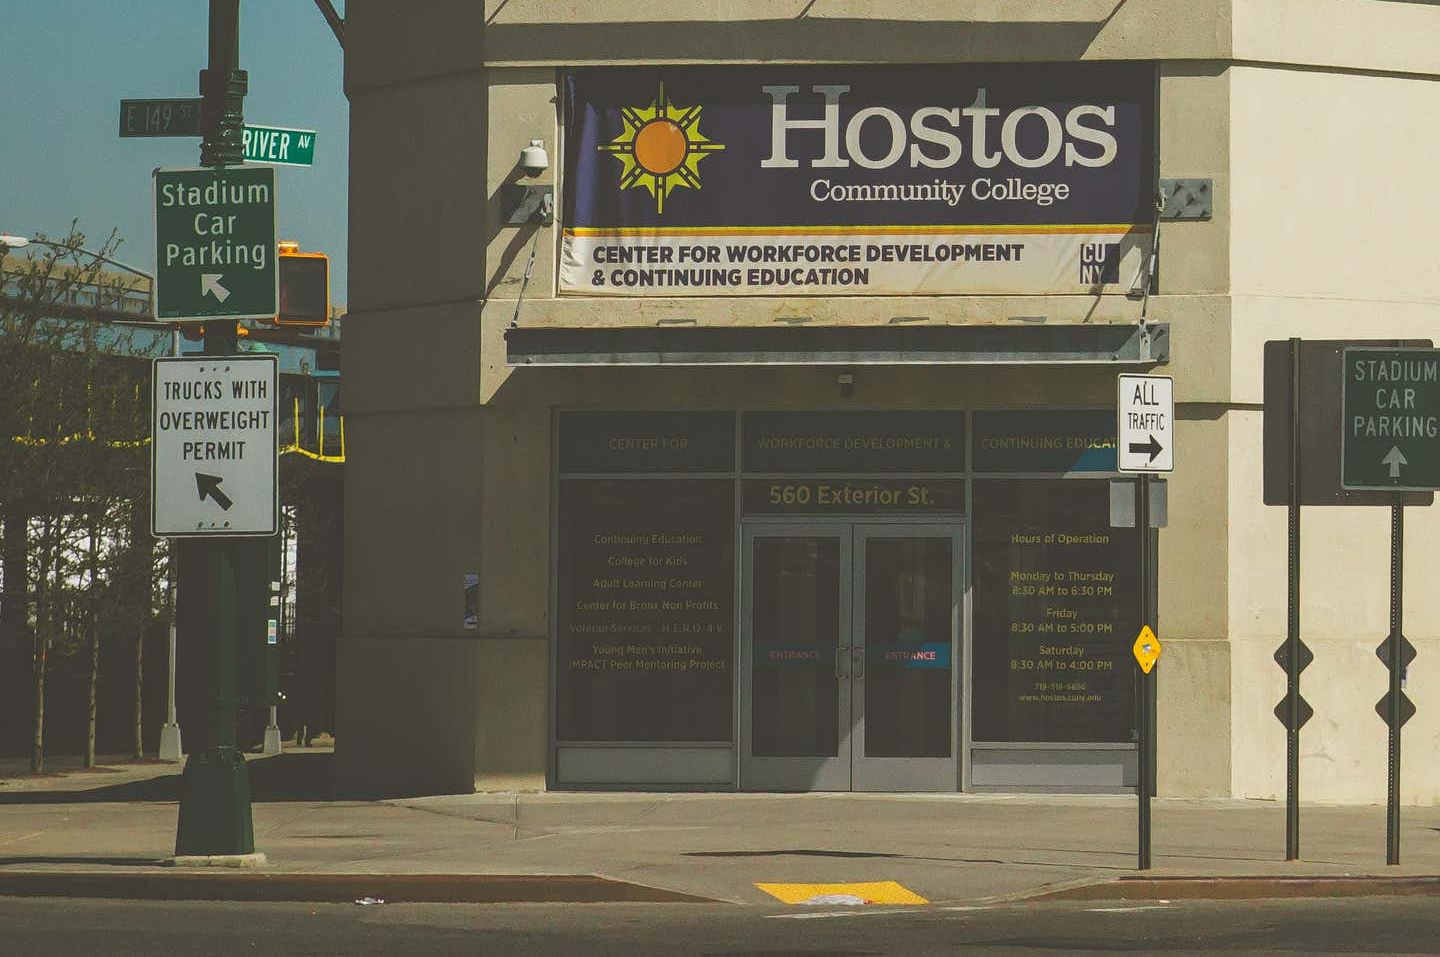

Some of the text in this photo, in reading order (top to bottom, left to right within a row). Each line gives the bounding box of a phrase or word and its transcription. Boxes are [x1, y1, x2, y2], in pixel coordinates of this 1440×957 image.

[127, 106, 136, 131] E
[145, 105, 173, 132] 149
[760, 84, 1118, 169] Hostos
[242, 129, 311, 160] RIVER AV
[162, 179, 269, 207] Stadium
[810, 178, 1070, 206] Community College
[194, 212, 237, 235] Car
[166, 240, 266, 269] Parking
[592, 243, 1025, 264] CENTER FOR WORKFORCE DEVELOPMENT
[591, 267, 869, 287] & CONTINUING EDUCATION
[1354, 360, 1438, 383] STADIUM
[163, 380, 268, 401] TRUCKS WITH
[1133, 384, 1160, 407] ALL
[1375, 388, 1416, 410] CAR
[159, 410, 270, 430] OVERWEIGHT
[1127, 412, 1165, 432] TRAFFIC
[1353, 416, 1438, 439] PARKING
[182, 441, 247, 461] PERMIT
[608, 438, 657, 450] CENTER
[758, 437, 841, 450] WORKFORCE
[844, 437, 941, 450] DEVELOPMENT
[982, 436, 1120, 450] CONTINUING EDUCAT
[770, 485, 935, 505] 560 Exterior St.
[593, 534, 704, 545] Continuing Education
[1011, 533, 1110, 545] Hours of Operation
[592, 578, 620, 588] Adult
[1010, 571, 1114, 583] Monday to Thursday
[1012, 586, 1112, 596] 8:30 AM to 6:30 PM
[1046, 607, 1078, 620] Friday
[1011, 623, 1112, 633] 8:30 AM to 5:00 PM
[769, 650, 820, 660] ENTRANCE
[885, 650, 937, 660] ENTRANCE
[1039, 645, 1085, 657] Saturday
[1036, 660, 1053, 670] AM
[1055, 660, 1067, 670] to
[1096, 660, 1112, 670] PM
